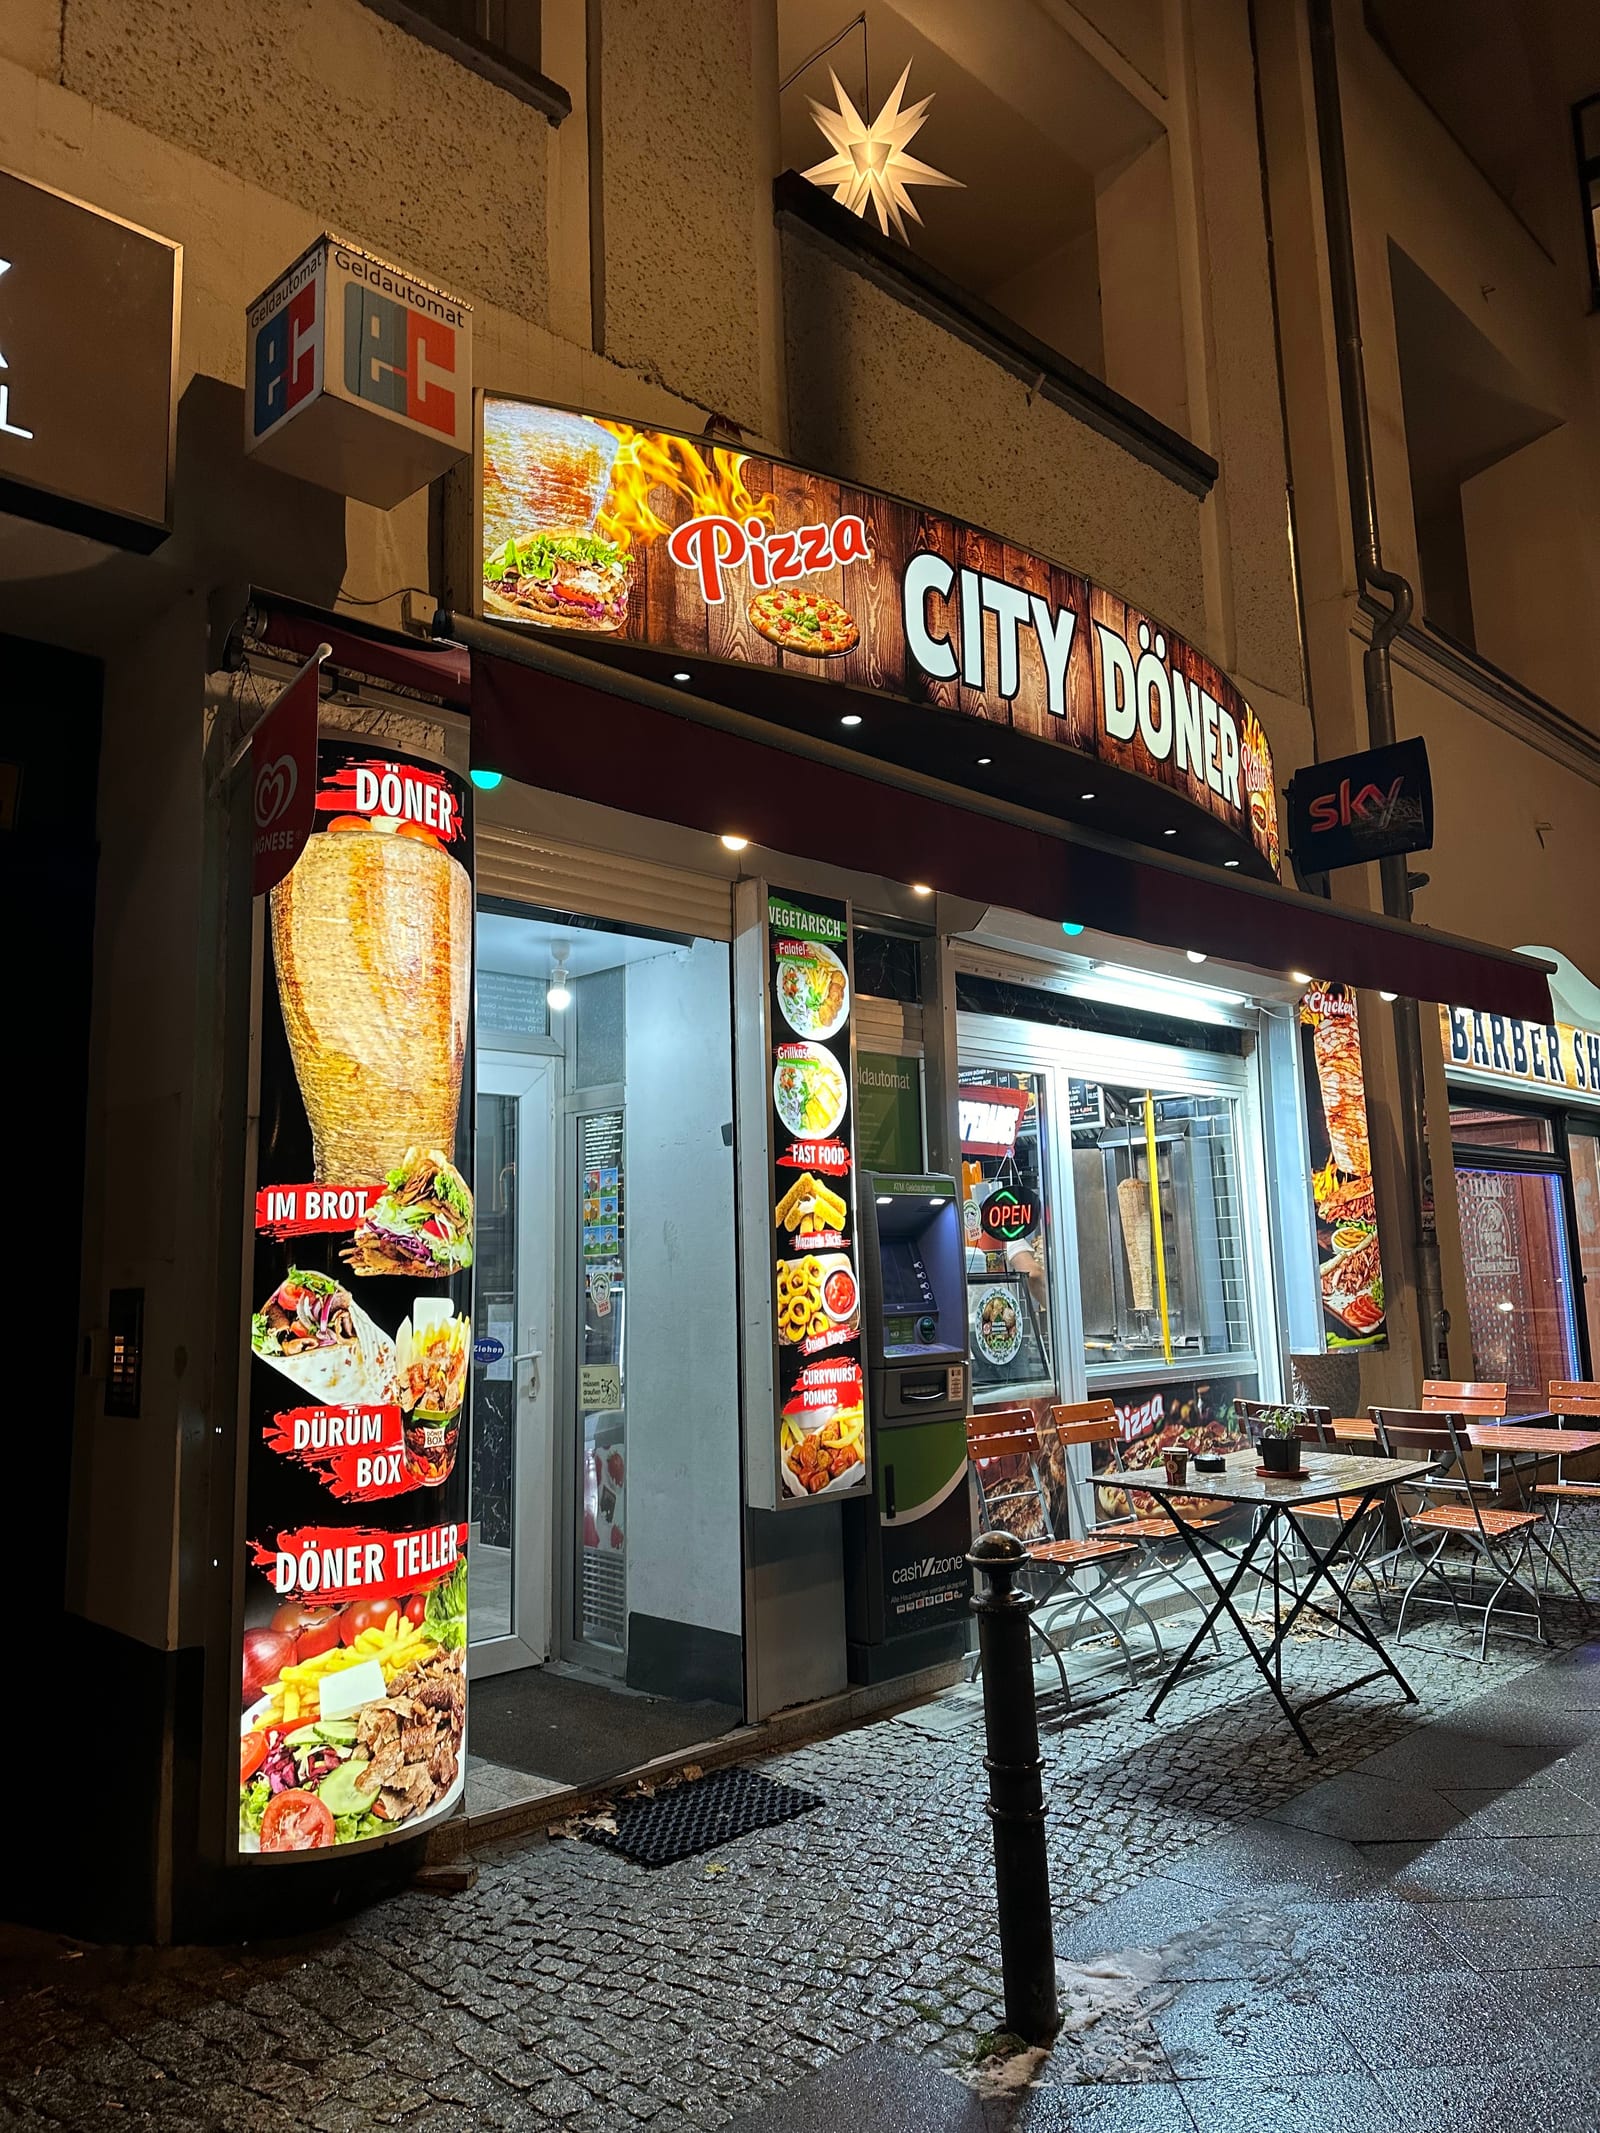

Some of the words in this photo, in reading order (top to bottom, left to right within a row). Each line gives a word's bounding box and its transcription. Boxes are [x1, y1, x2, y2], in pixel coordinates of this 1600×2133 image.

[250, 250, 323, 329] Geldautomat
[335, 250, 464, 328] Geldautomat
[668, 515, 870, 604] Pizza
[904, 552, 1077, 717] CITY
[1096, 621, 1242, 810] DÖNER
[356, 764, 451, 834] DÖNER
[1308, 776, 1404, 833] sky
[254, 831, 294, 855] NGNESE
[769, 905, 841, 938] VEGETARISCH
[779, 942, 806, 956] Falafel
[1449, 1006, 1565, 1083] BARBER
[857, 1066, 910, 1090] ldautomat
[792, 1144, 816, 1165] FAST
[818, 1145, 845, 1165] FOOD
[267, 1191, 294, 1221] IM
[305, 1190, 368, 1220] BROT
[989, 1204, 1031, 1227] OPEN
[806, 1335, 826, 1352] Onion
[826, 1328, 847, 1344] Rings
[803, 1367, 856, 1386] CURRYWURST
[803, 1388, 838, 1406] POMMES
[294, 1410, 382, 1449] DÜRÜM
[427, 1437, 443, 1445] BOX
[356, 1455, 401, 1488] BOX
[275, 1541, 384, 1594] DÖNER
[394, 1524, 459, 1579] TELLER
